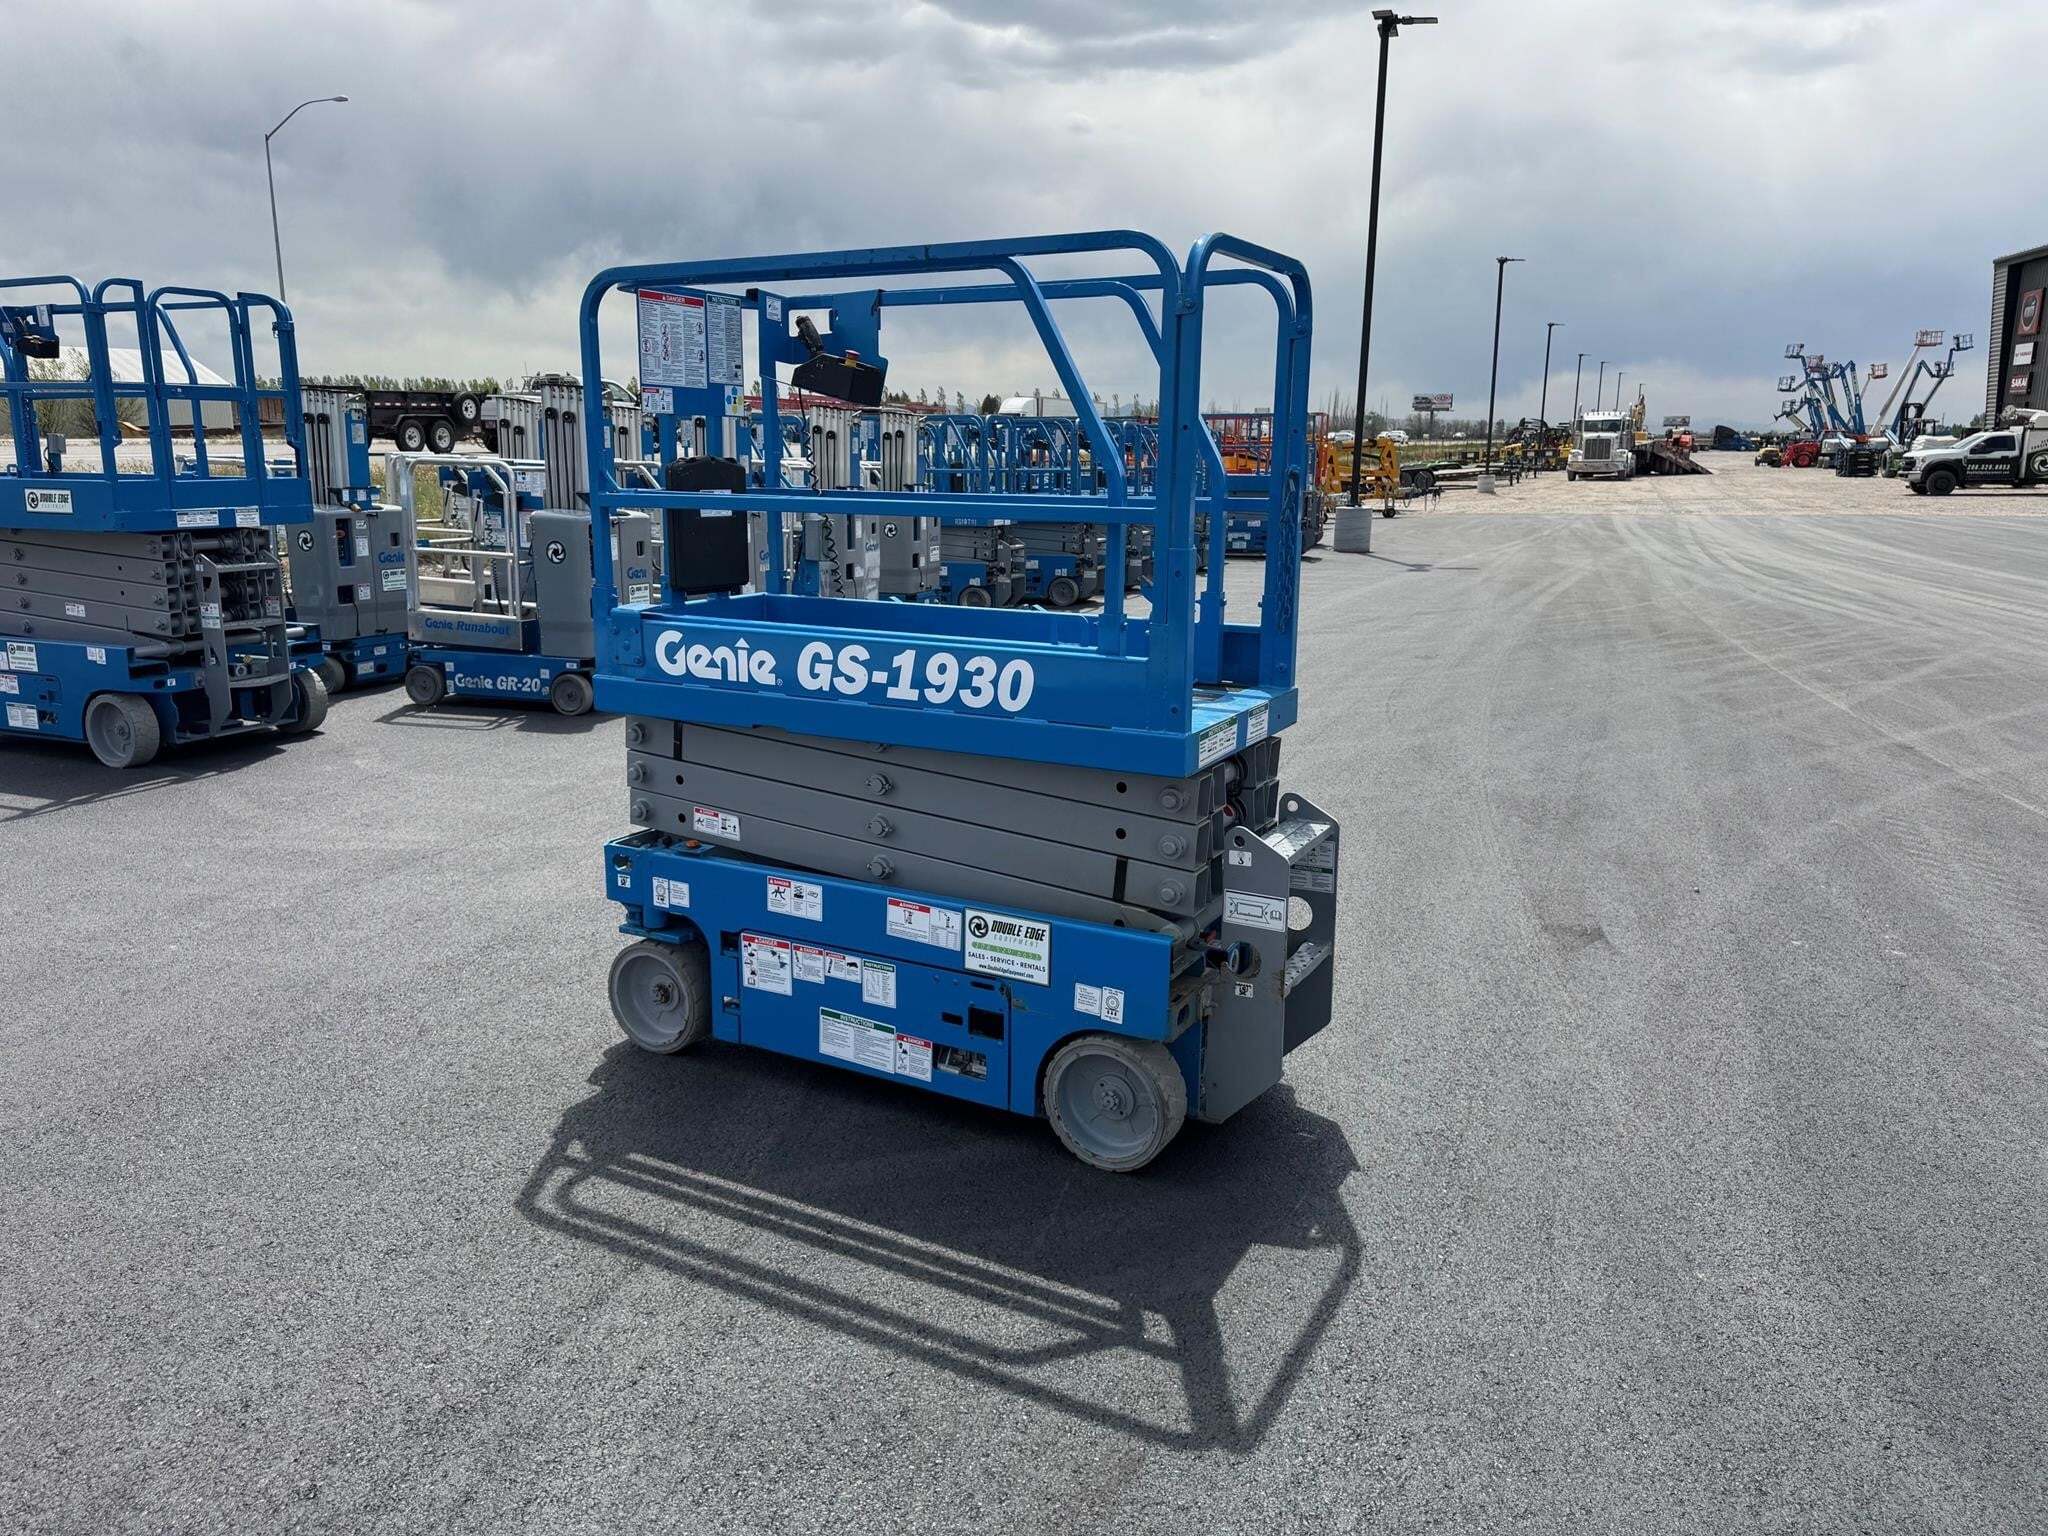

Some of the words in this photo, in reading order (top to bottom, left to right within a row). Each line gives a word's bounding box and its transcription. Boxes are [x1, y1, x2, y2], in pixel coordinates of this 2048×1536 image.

[2011, 378, 2028, 388] SAKAI
[425, 617, 453, 631] Genie
[456, 620, 510, 635] Runabout
[654, 629, 777, 686] Genie
[797, 641, 1035, 712] GS-1930
[454, 673, 493, 689] Genie
[496, 676, 540, 692] GR-20
[991, 920, 1023, 937] DOUBLE
[1024, 926, 1046, 941] EDGE
[968, 951, 985, 960] SALES
[990, 956, 1015, 966] SERVICE
[1020, 962, 1046, 973] RENTALS
[840, 1014, 874, 1029] INSTRUCTIONS
